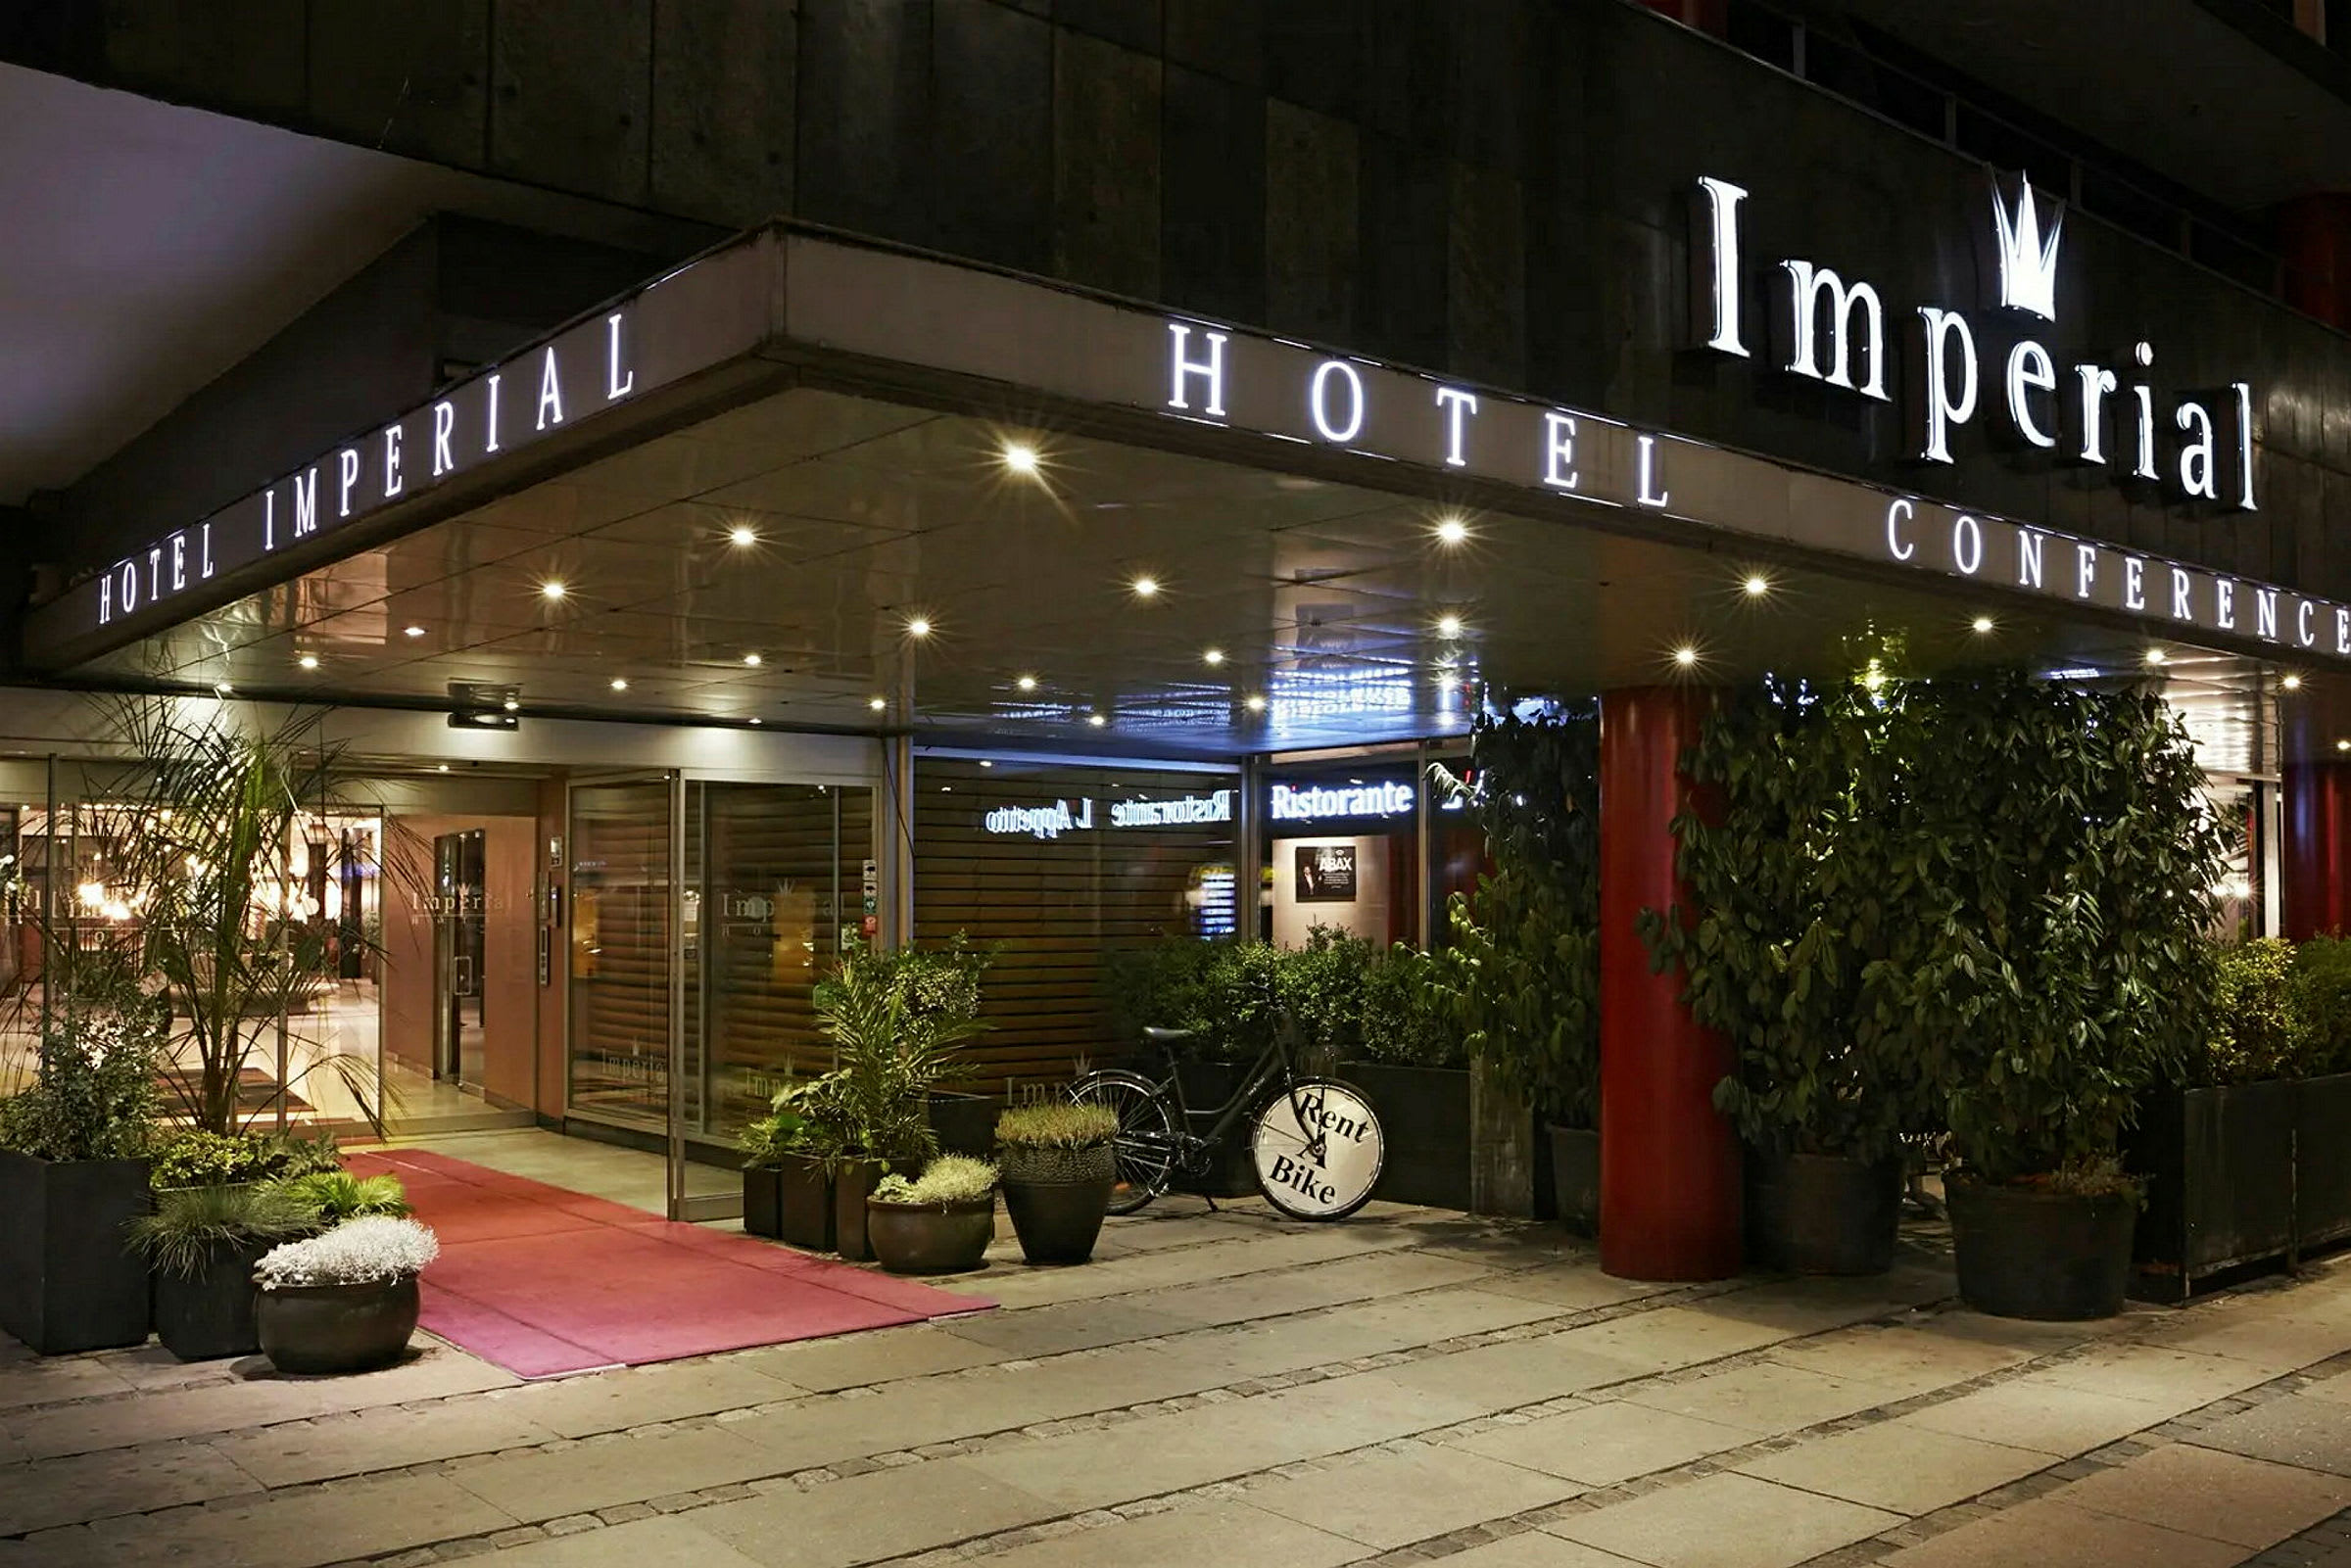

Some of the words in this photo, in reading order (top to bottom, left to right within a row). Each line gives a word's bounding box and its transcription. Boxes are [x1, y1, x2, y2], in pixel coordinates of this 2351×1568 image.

[1698, 175, 2258, 510] Imperial
[99, 522, 214, 625] HOTEL
[264, 312, 633, 550] IMPERIAL
[1168, 323, 1669, 507] HOTEL
[1888, 498, 2350, 654] CONFERENCE
[1271, 782, 1415, 820] Ristorante
[1300, 1092, 1369, 1144] Rent
[1295, 1131, 1326, 1169] A
[1270, 1154, 1336, 1205] Bike
